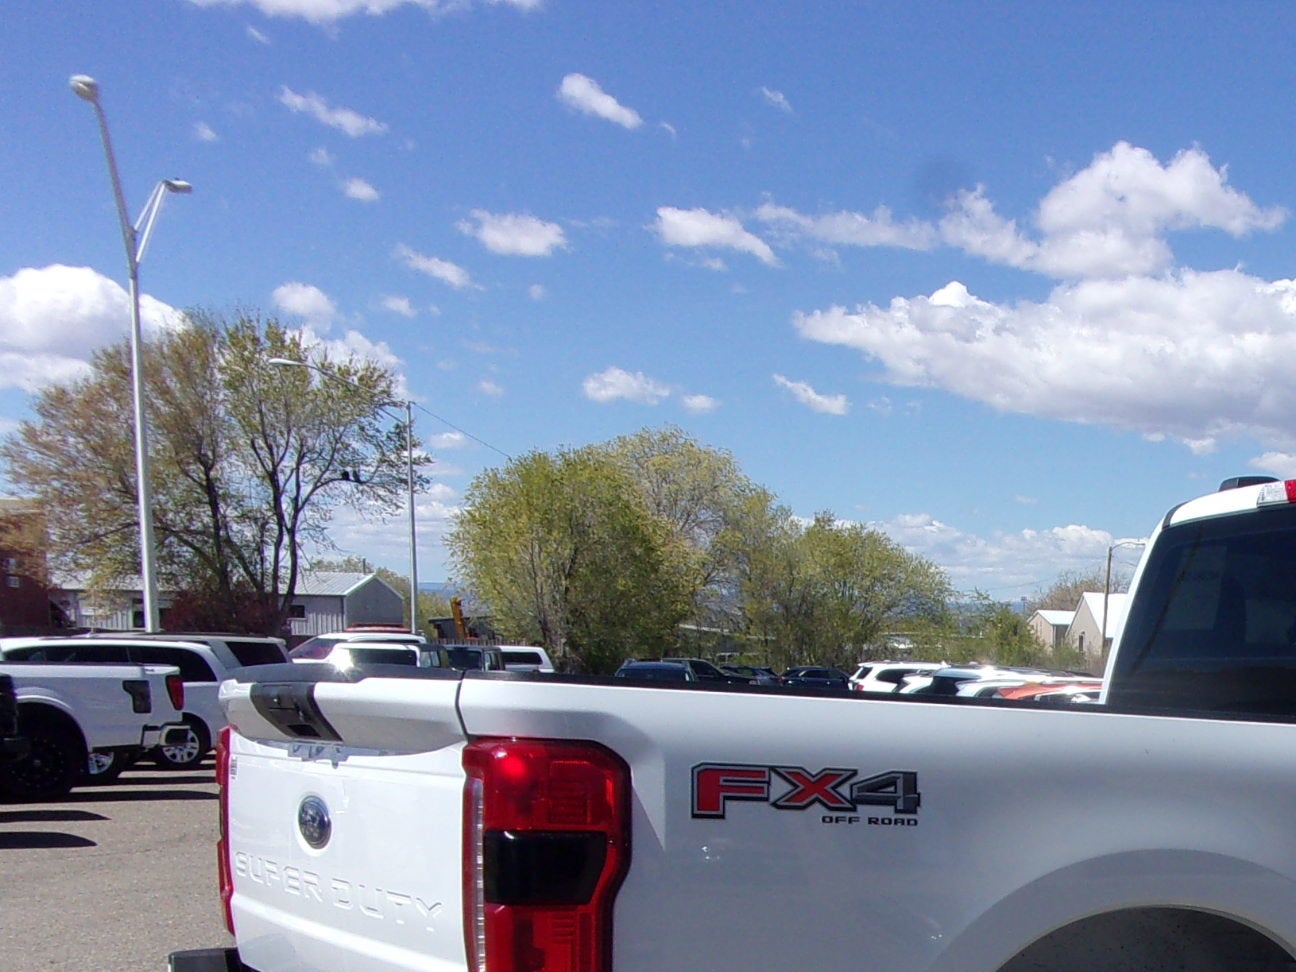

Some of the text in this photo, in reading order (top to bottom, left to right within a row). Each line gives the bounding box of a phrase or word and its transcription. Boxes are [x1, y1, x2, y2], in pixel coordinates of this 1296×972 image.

[691, 762, 921, 819] FX4
[821, 815, 919, 827] OFF ROAD
[235, 851, 443, 932] SUPER DUTY
